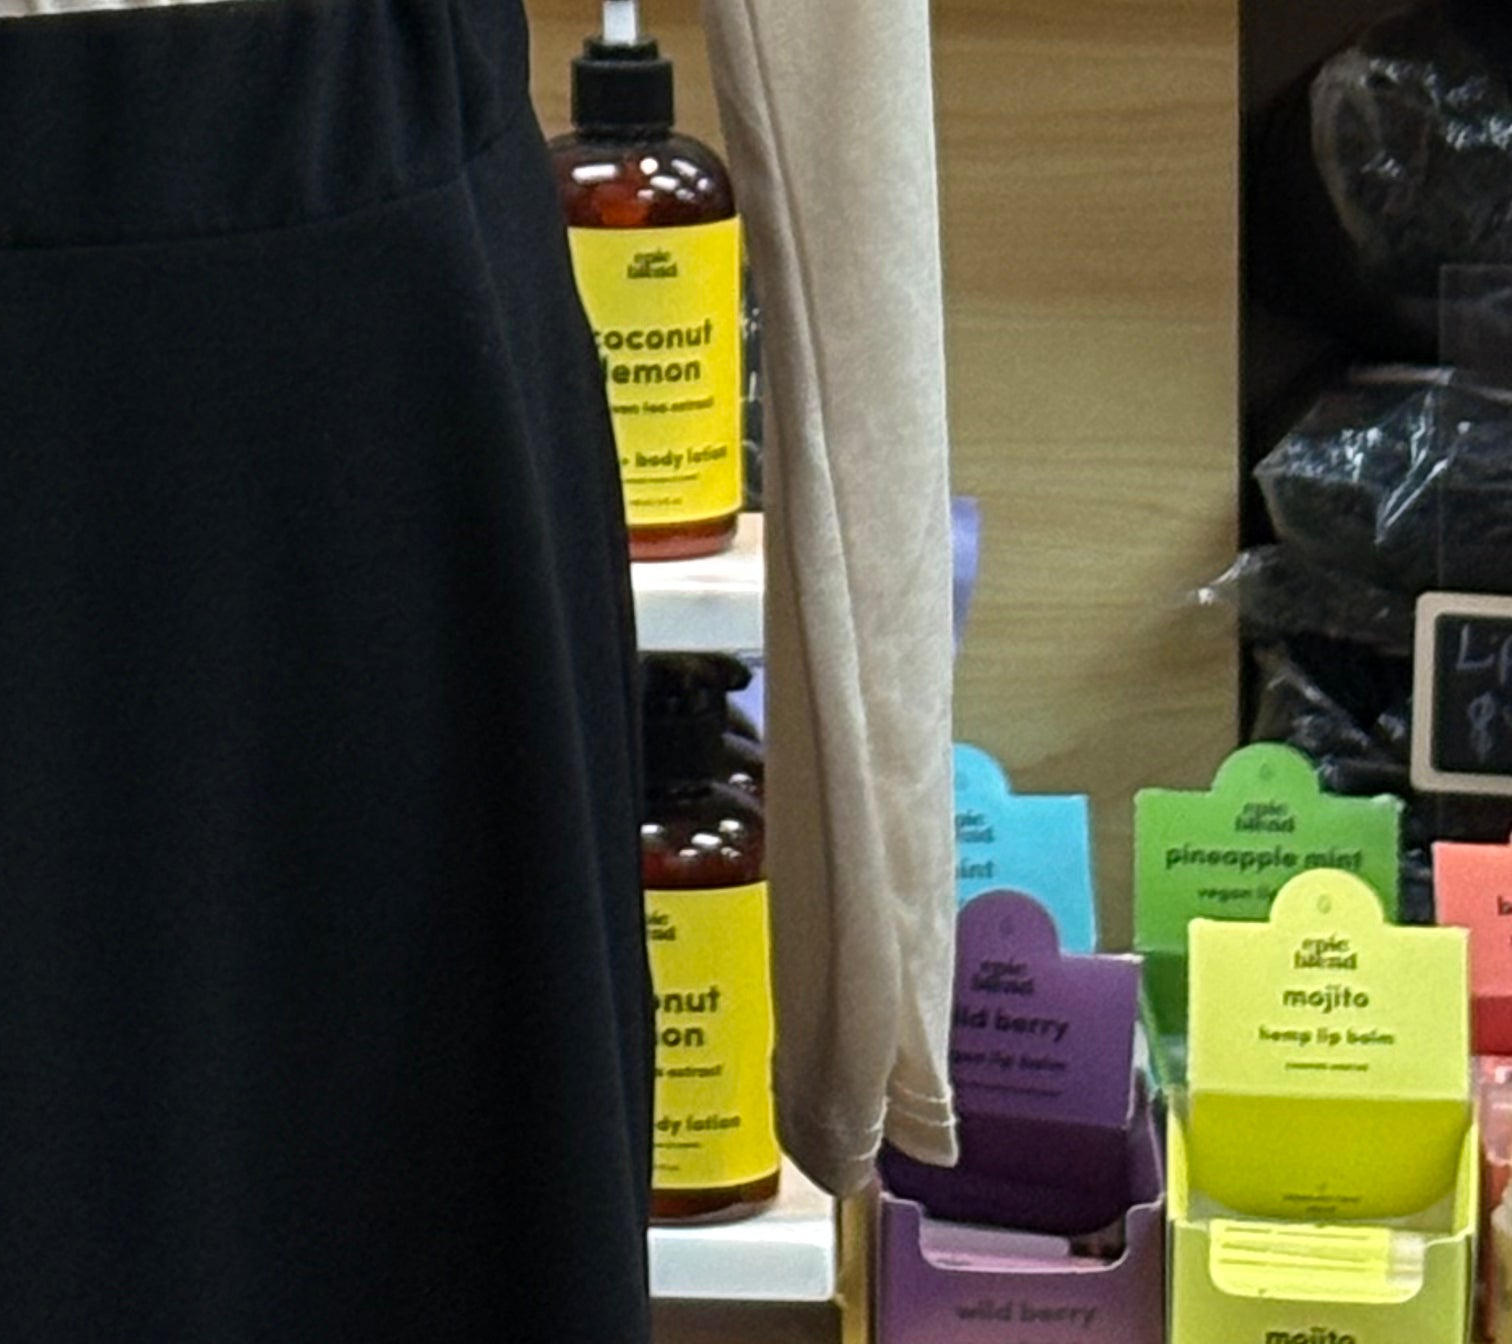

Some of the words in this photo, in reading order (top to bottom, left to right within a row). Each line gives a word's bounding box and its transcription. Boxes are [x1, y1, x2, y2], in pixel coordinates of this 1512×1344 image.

[594, 318, 712, 350] oconut
[955, 858, 994, 881] int
[1165, 842, 1298, 872] pineapple
[1303, 846, 1363, 870] mint
[1302, 932, 1350, 956] epic
[1293, 951, 1358, 970] blend
[1282, 985, 1370, 1014] mojito
[994, 1007, 1069, 1043] berry
[1316, 1027, 1341, 1047] lip
[1346, 1029, 1395, 1046] balm
